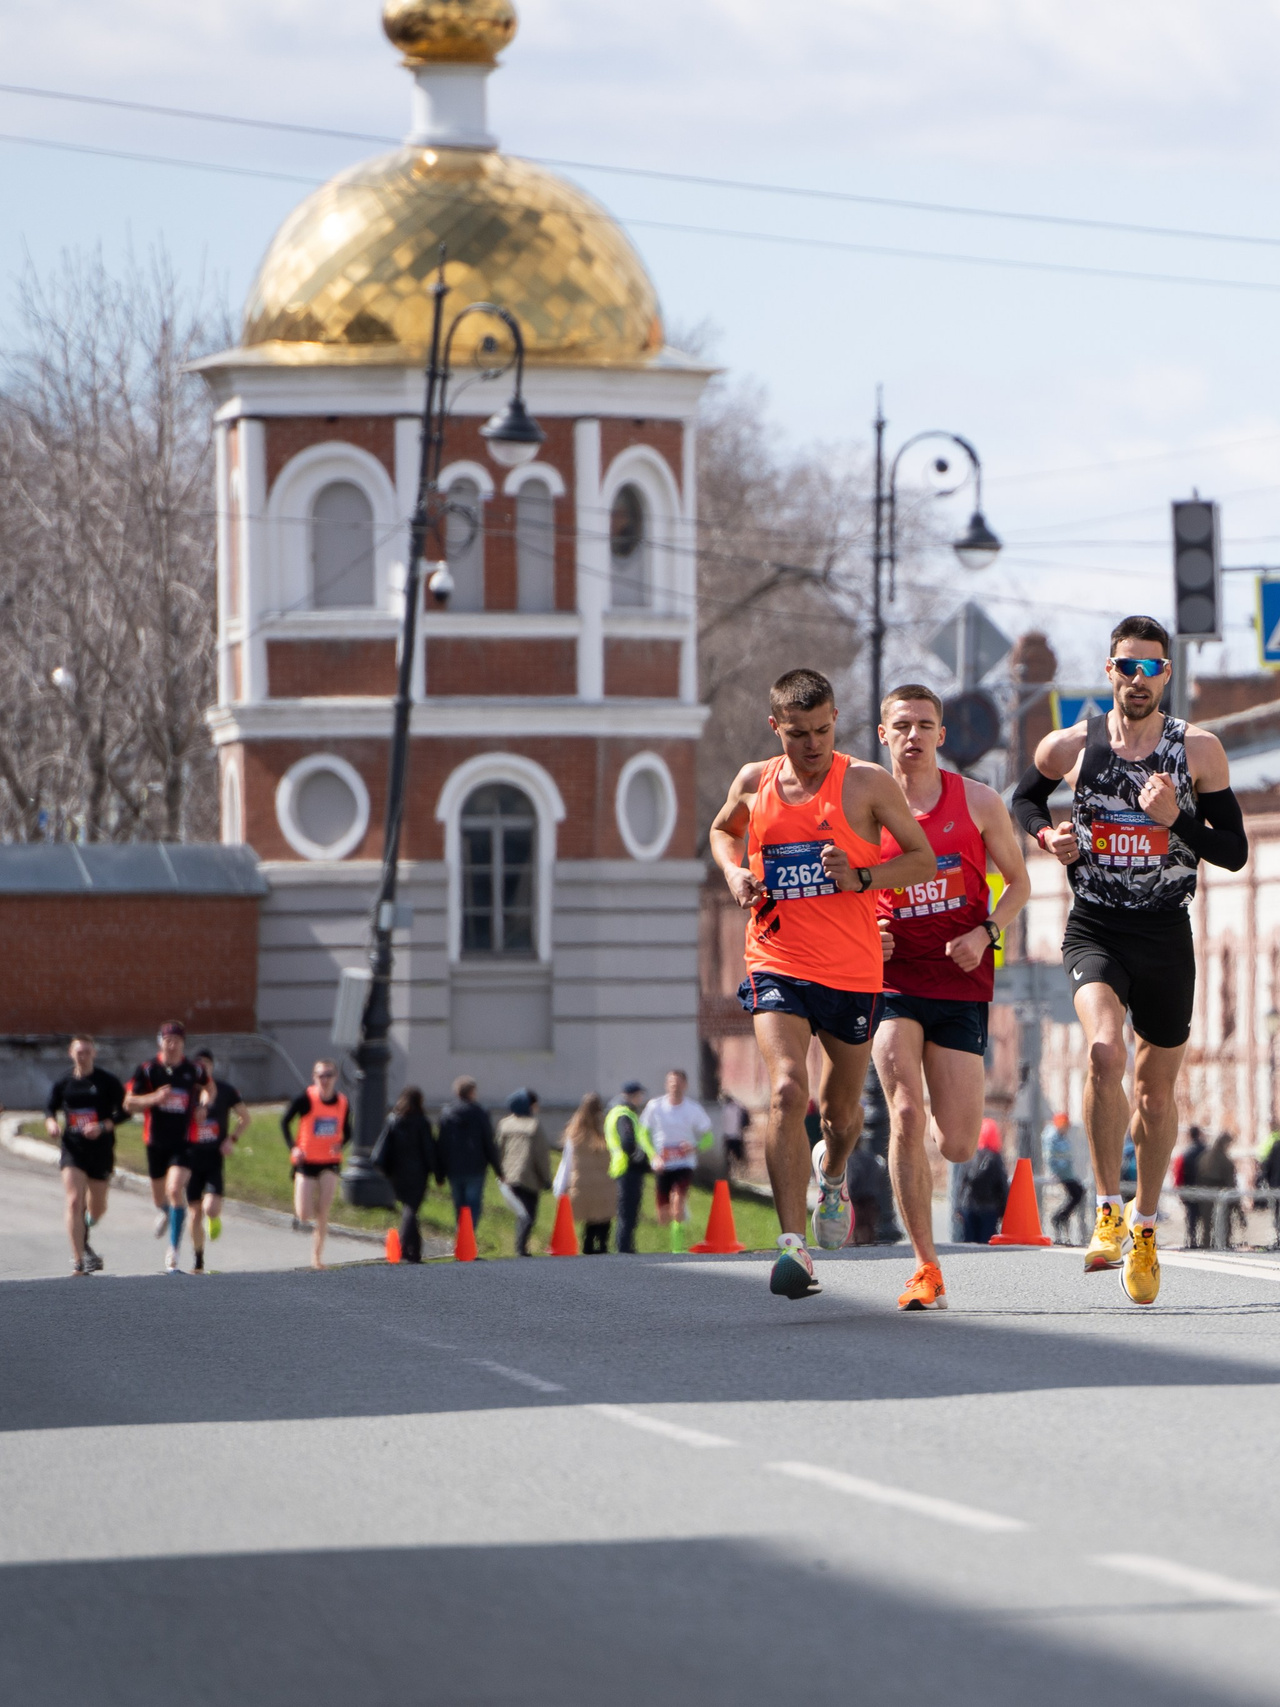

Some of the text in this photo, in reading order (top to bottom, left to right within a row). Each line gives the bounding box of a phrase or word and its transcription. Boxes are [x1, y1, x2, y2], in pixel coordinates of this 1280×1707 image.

[1108, 833, 1151, 854] 1014
[777, 863, 824, 887] 2362
[905, 878, 947, 904] 1567
